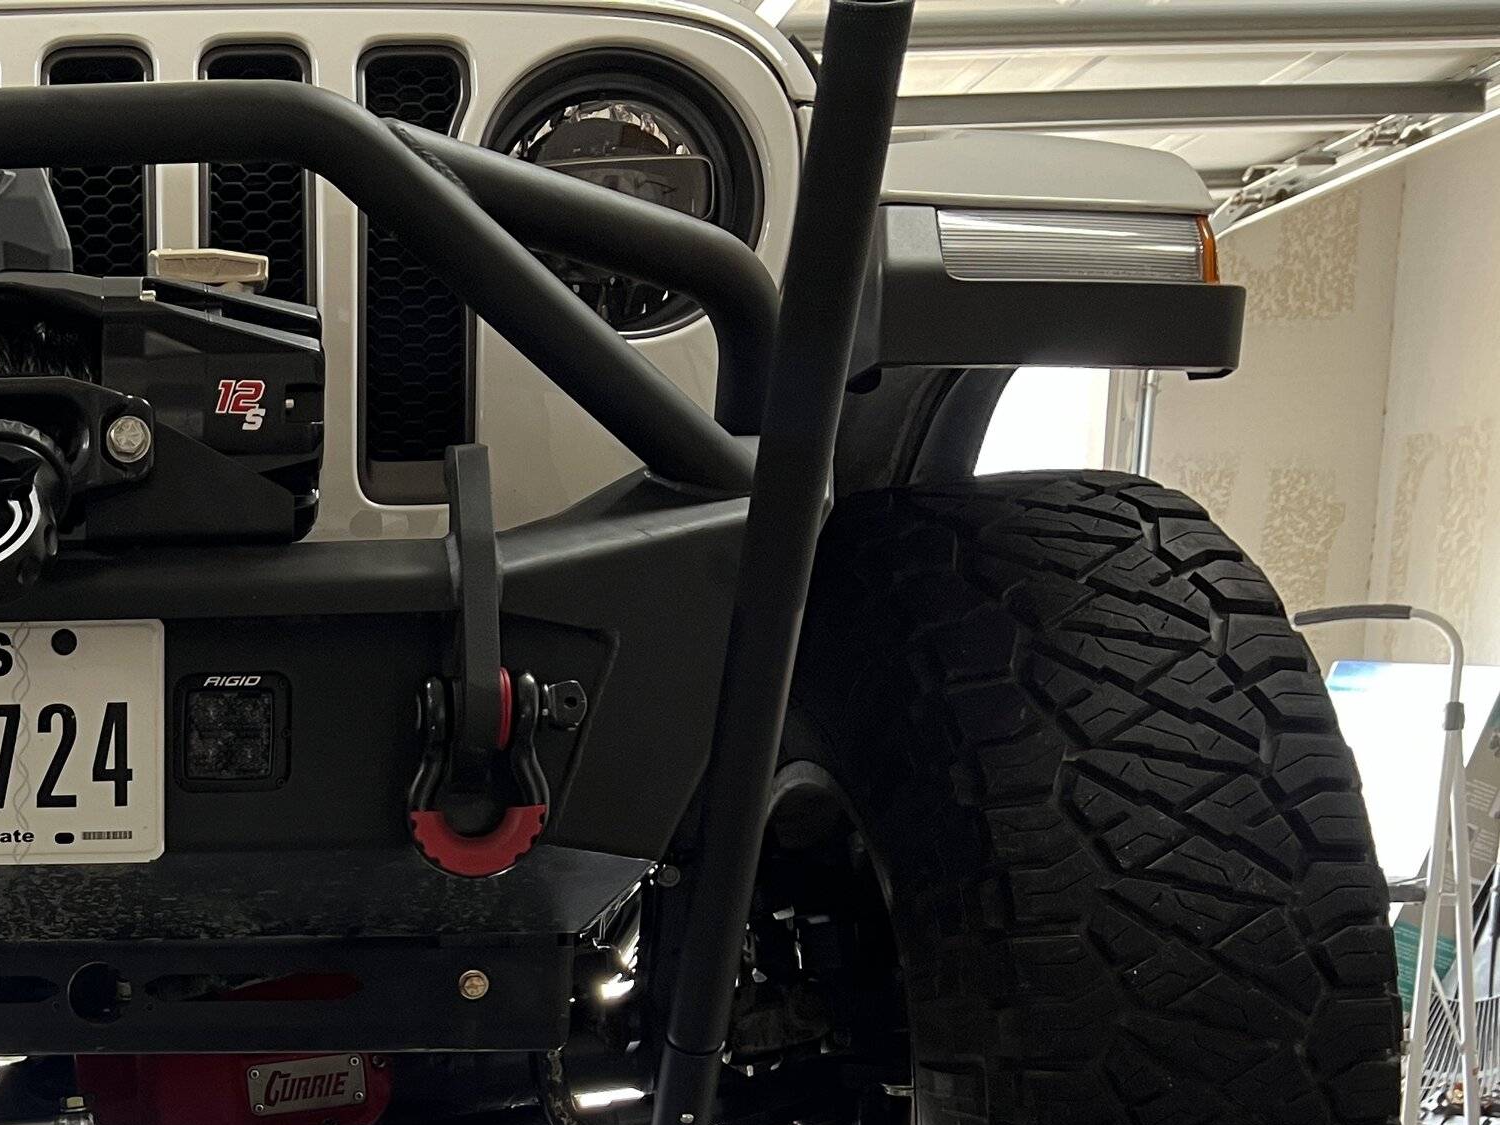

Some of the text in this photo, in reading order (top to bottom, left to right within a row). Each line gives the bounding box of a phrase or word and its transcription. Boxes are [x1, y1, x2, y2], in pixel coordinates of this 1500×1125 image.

[215, 380, 266, 414] 12
[204, 675, 262, 687] RIGID
[265, 1070, 348, 1107] CURRIE
